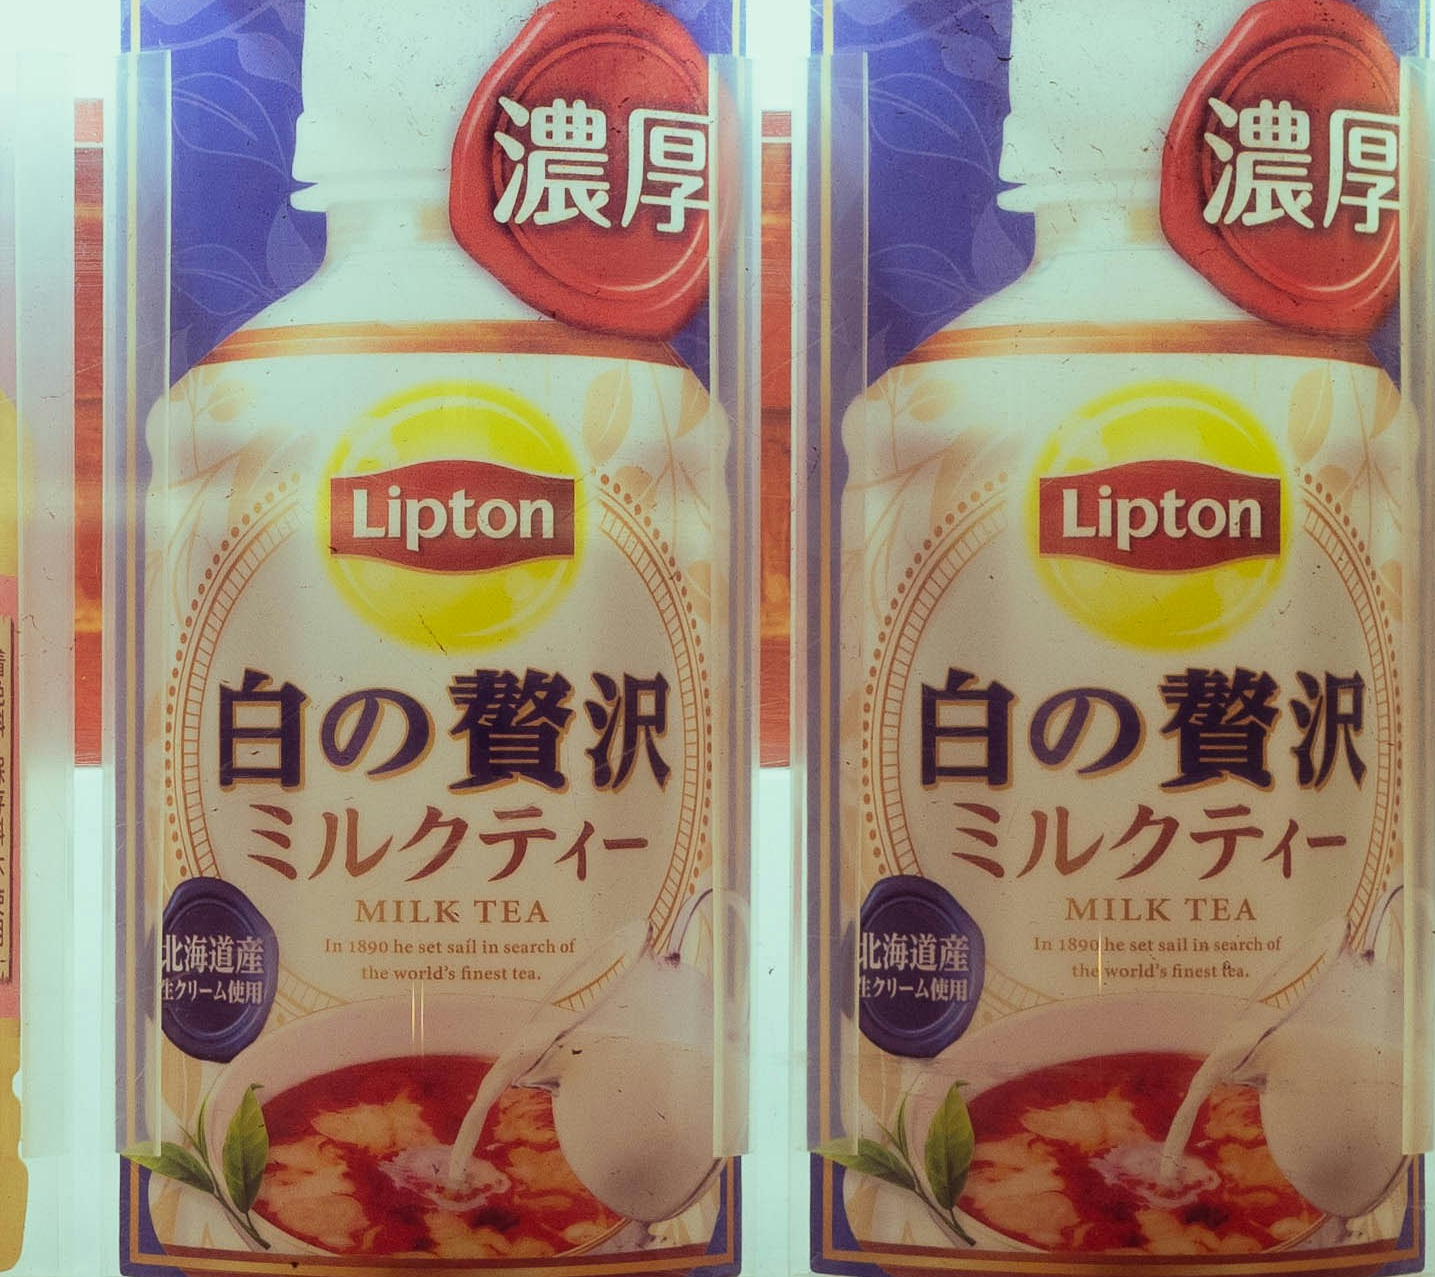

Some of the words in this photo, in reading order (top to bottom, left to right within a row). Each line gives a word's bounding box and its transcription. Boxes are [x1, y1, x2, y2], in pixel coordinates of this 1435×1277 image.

[493, 96, 711, 233] 濃厚
[1203, 96, 1401, 234] 濃厚
[352, 486, 554, 551] Lipton
[1062, 486, 1262, 550] Lipton
[218, 666, 671, 793] 白の贅沢
[921, 666, 1366, 792] 白の贅沢
[247, 802, 648, 883] ミルクティー
[952, 801, 1346, 880] ミルクティー
[356, 899, 461, 924] MILK
[474, 899, 549, 924] TEA
[1066, 898, 1169, 922] MILK
[1184, 898, 1256, 922] TEA
[162, 934, 264, 974] 北海道産
[325, 939, 344, 955] In
[348, 939, 388, 955] 1890
[393, 939, 411, 955] he
[416, 939, 441, 955] set
[446, 939, 477, 955] sail
[481, 939, 498, 955] in
[504, 939, 555, 955] search
[559, 939, 576, 955] of
[859, 932, 968, 971] 北海道産
[1034, 936, 1053, 953] In
[1058, 936, 1098, 953] 1890
[1103, 936, 1124, 953] he
[1129, 936, 1153, 953] set
[1158, 936, 1187, 953] sail
[1193, 936, 1209, 953] in
[1213, 936, 1261, 953] search
[1266, 936, 1282, 953] of
